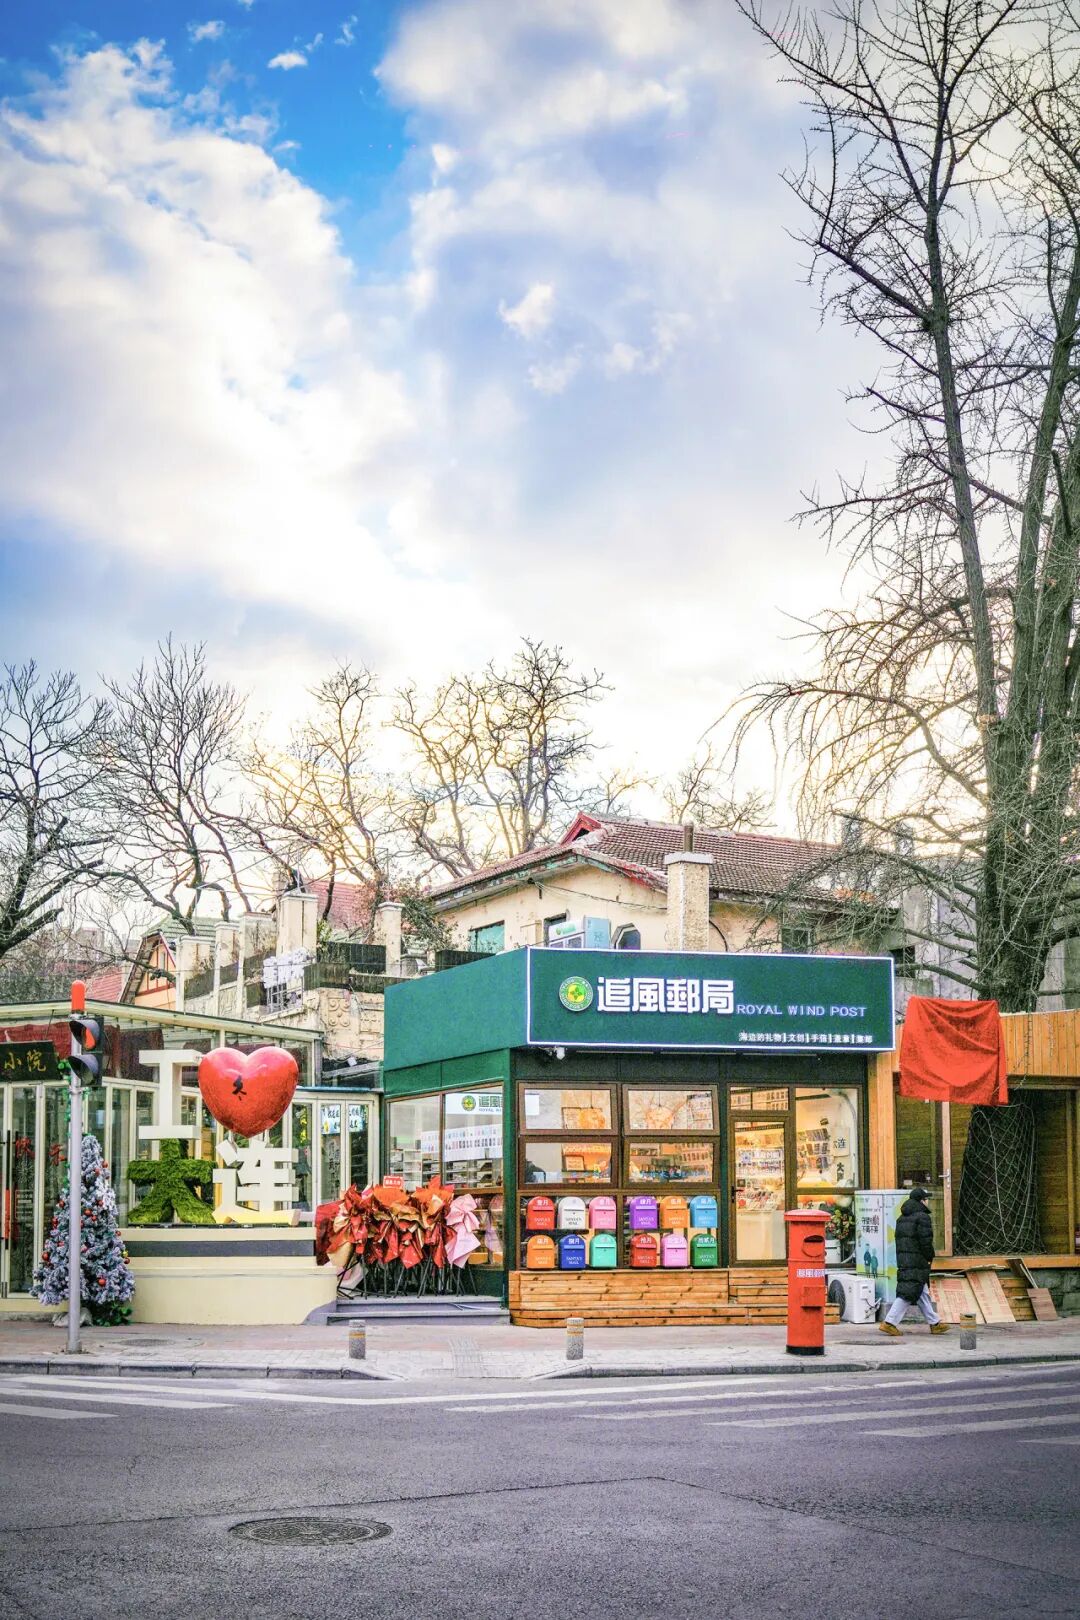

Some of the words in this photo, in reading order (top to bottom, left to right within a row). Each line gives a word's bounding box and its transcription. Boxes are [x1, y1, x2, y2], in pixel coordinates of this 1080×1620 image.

[735, 1004, 783, 1015] ROYAL
[787, 1005, 825, 1016] WIND
[830, 1006, 867, 1017] POST
